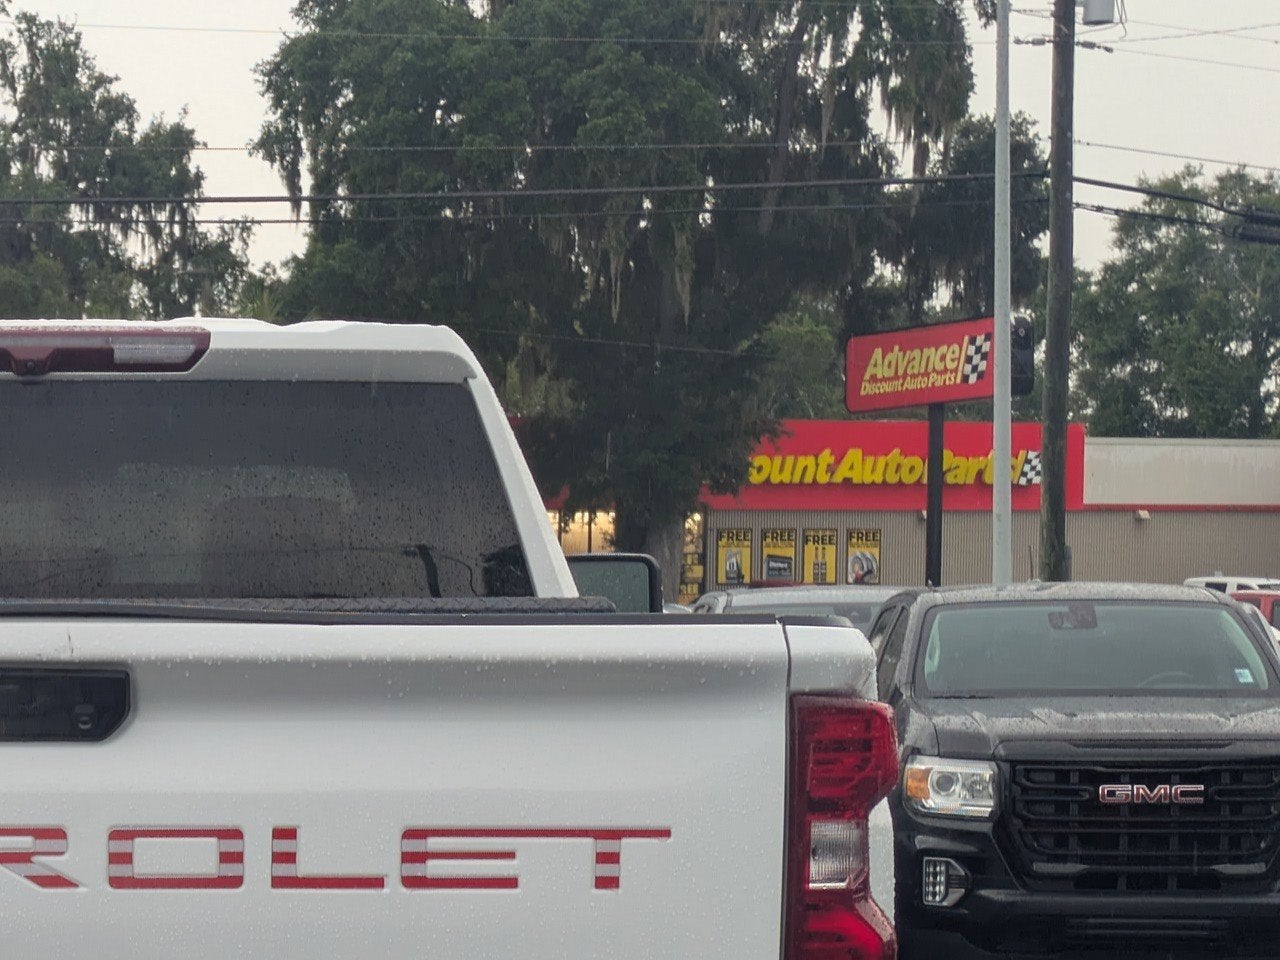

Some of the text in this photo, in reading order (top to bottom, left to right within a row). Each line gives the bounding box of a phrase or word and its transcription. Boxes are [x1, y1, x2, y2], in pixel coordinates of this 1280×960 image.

[863, 344, 960, 379] Advance
[860, 370, 957, 396] Discount Auto Parts
[831, 448, 925, 485] Auto
[720, 530, 751, 542] FREE
[763, 530, 795, 542] FREE
[805, 534, 836, 546] FREE
[849, 531, 880, 542] FREE
[1099, 784, 1205, 804] GMC
